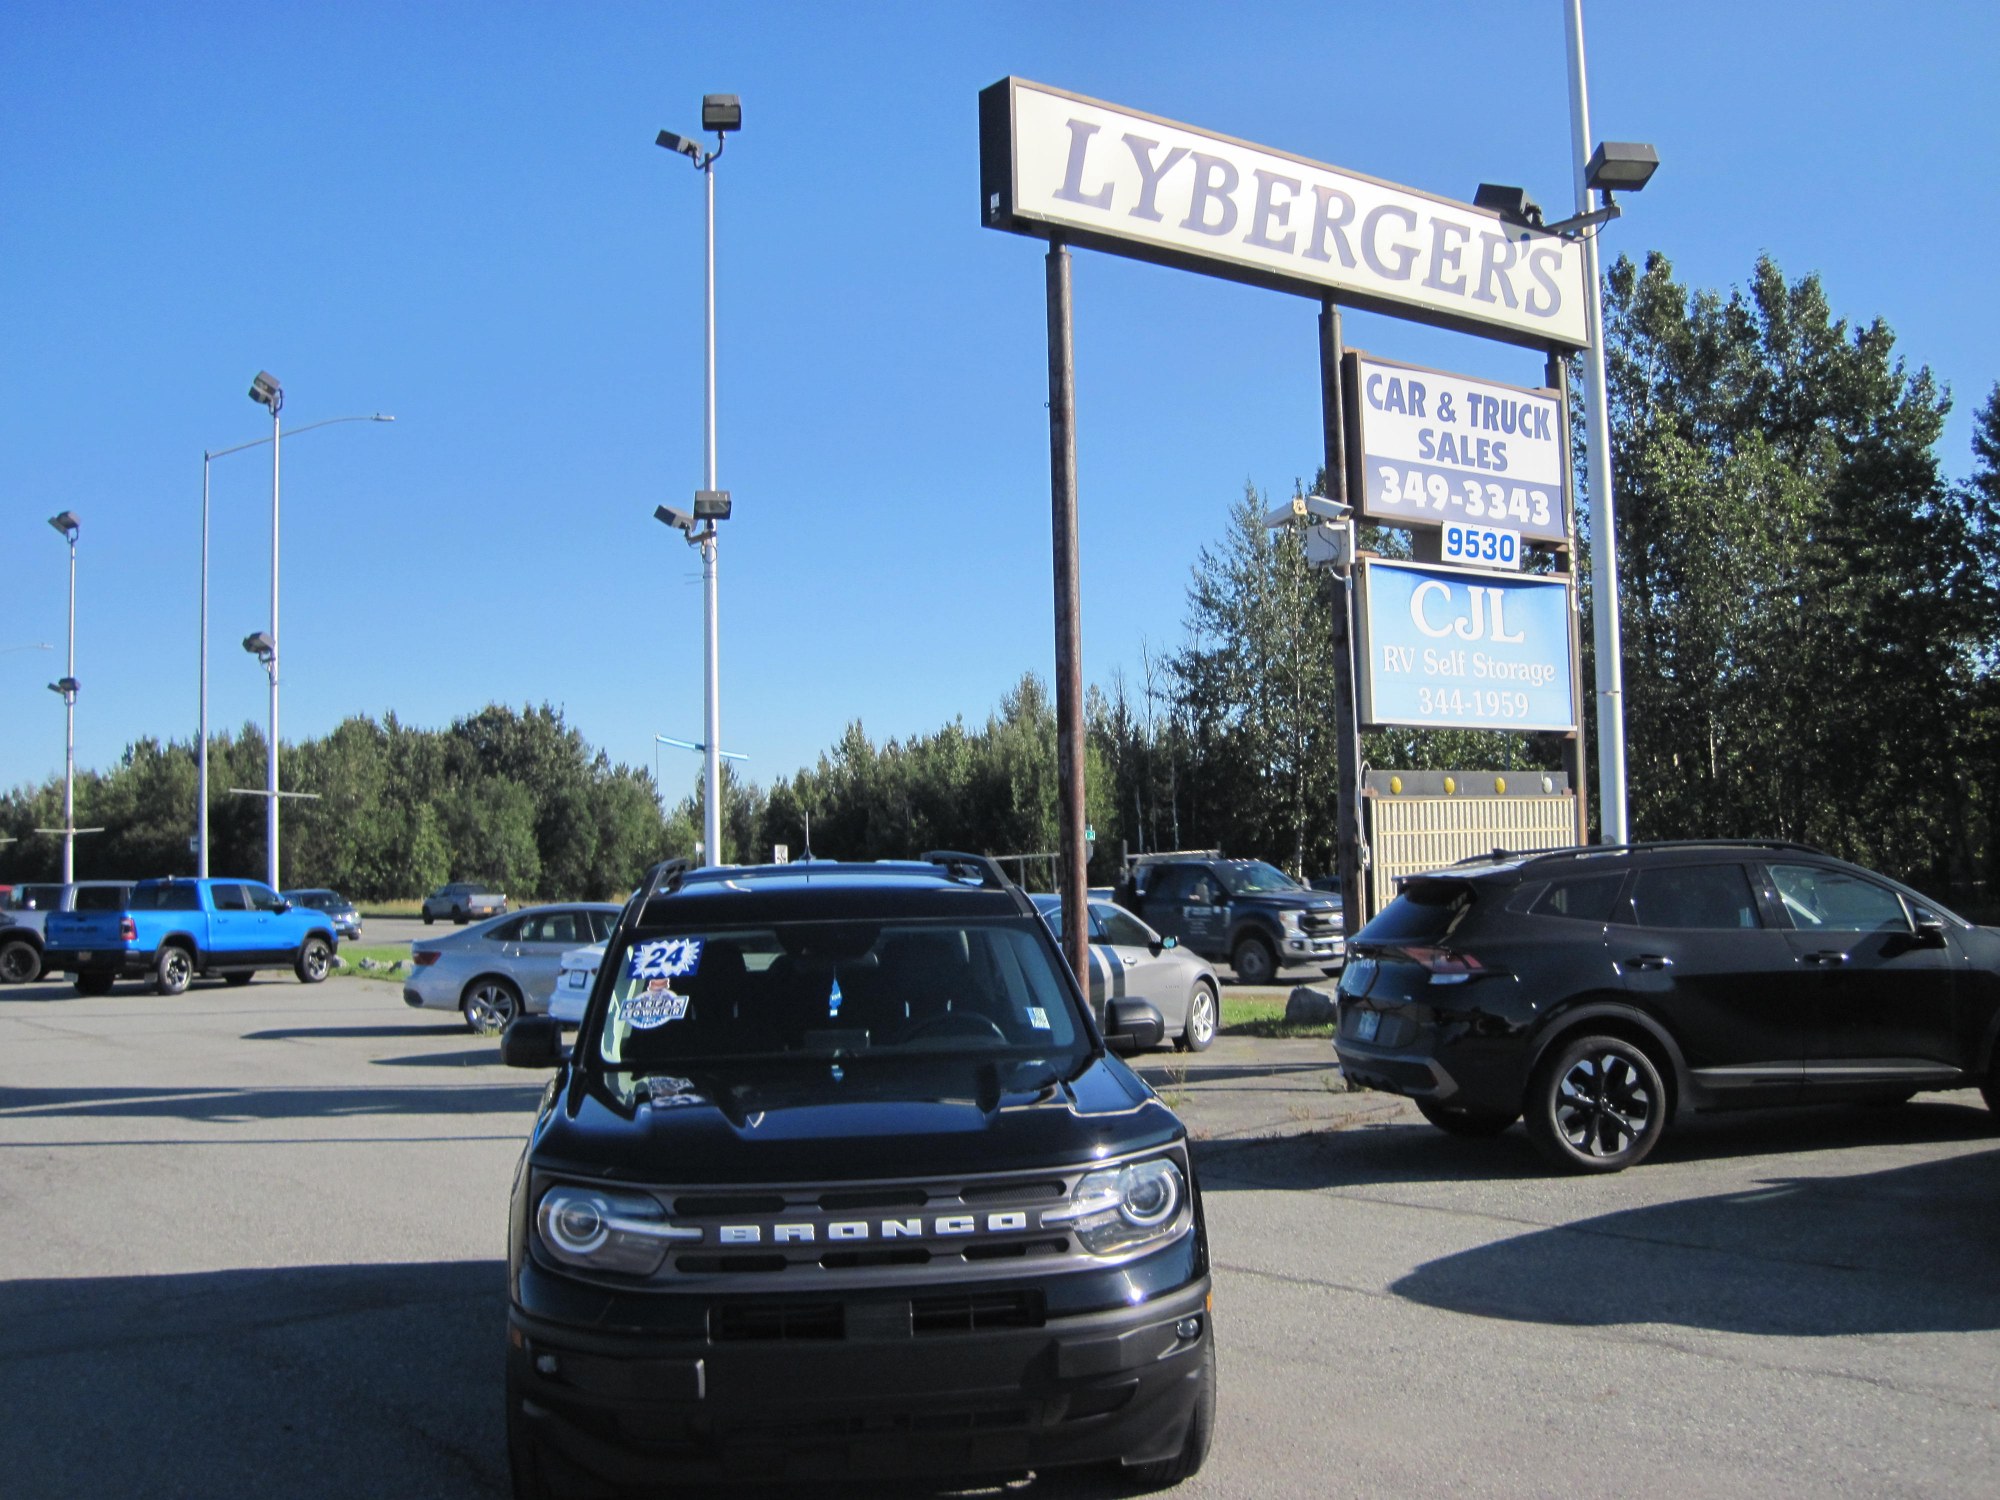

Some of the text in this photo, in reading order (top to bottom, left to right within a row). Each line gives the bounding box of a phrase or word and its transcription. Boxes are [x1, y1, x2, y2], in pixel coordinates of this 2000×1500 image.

[1053, 118, 1562, 318] LYBERGER'S
[1366, 373, 1552, 441] CAR & TRUCK
[1418, 428, 1508, 472] SALES
[1378, 466, 1551, 526] 349-3343
[1447, 527, 1515, 563] 9530
[1410, 580, 1525, 643] CJL
[1382, 644, 1556, 687] RV Self Storage
[1419, 687, 1530, 719] 344-1959
[645, 947, 685, 969] 24
[719, 1212, 1026, 1243] BRONCO
